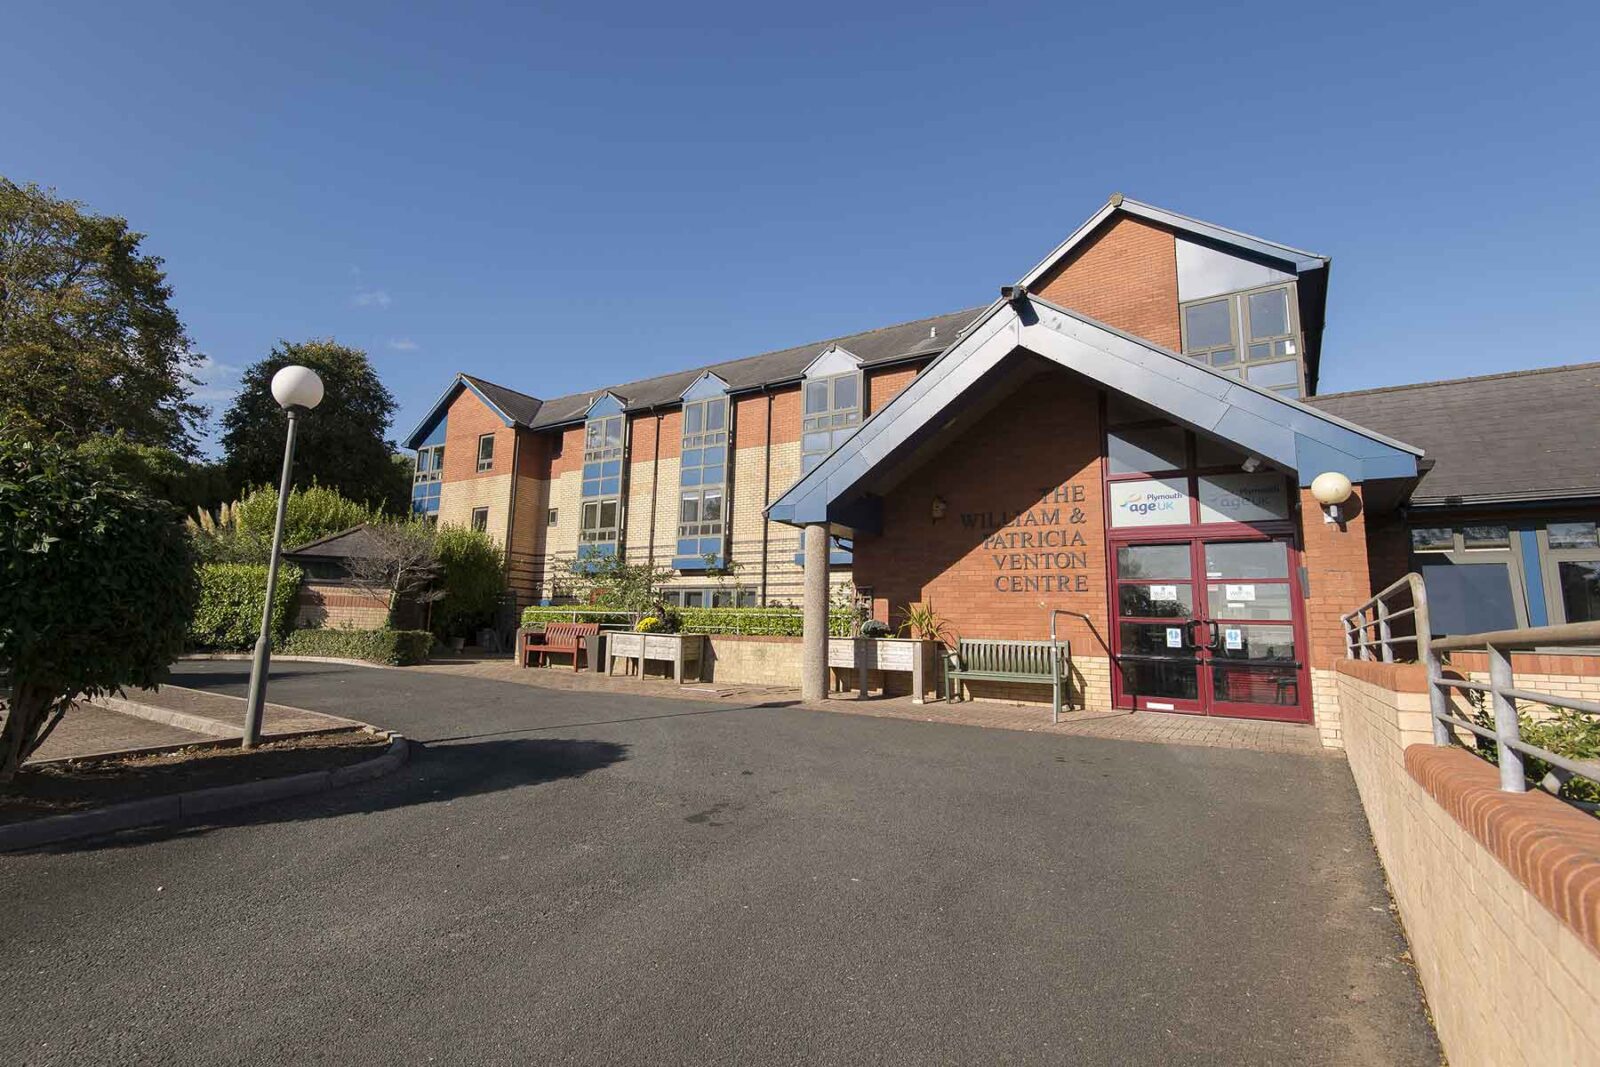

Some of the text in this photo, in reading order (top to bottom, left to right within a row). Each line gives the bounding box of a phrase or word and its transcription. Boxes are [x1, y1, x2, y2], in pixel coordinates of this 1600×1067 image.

[1040, 485, 1085, 504] THE
[1147, 492, 1182, 501] Plymouth
[960, 507, 1087, 528] WILLIAM &
[982, 530, 1087, 550] PATRICIA
[992, 551, 1087, 570] VENTON
[995, 575, 1089, 592] CENTRE
